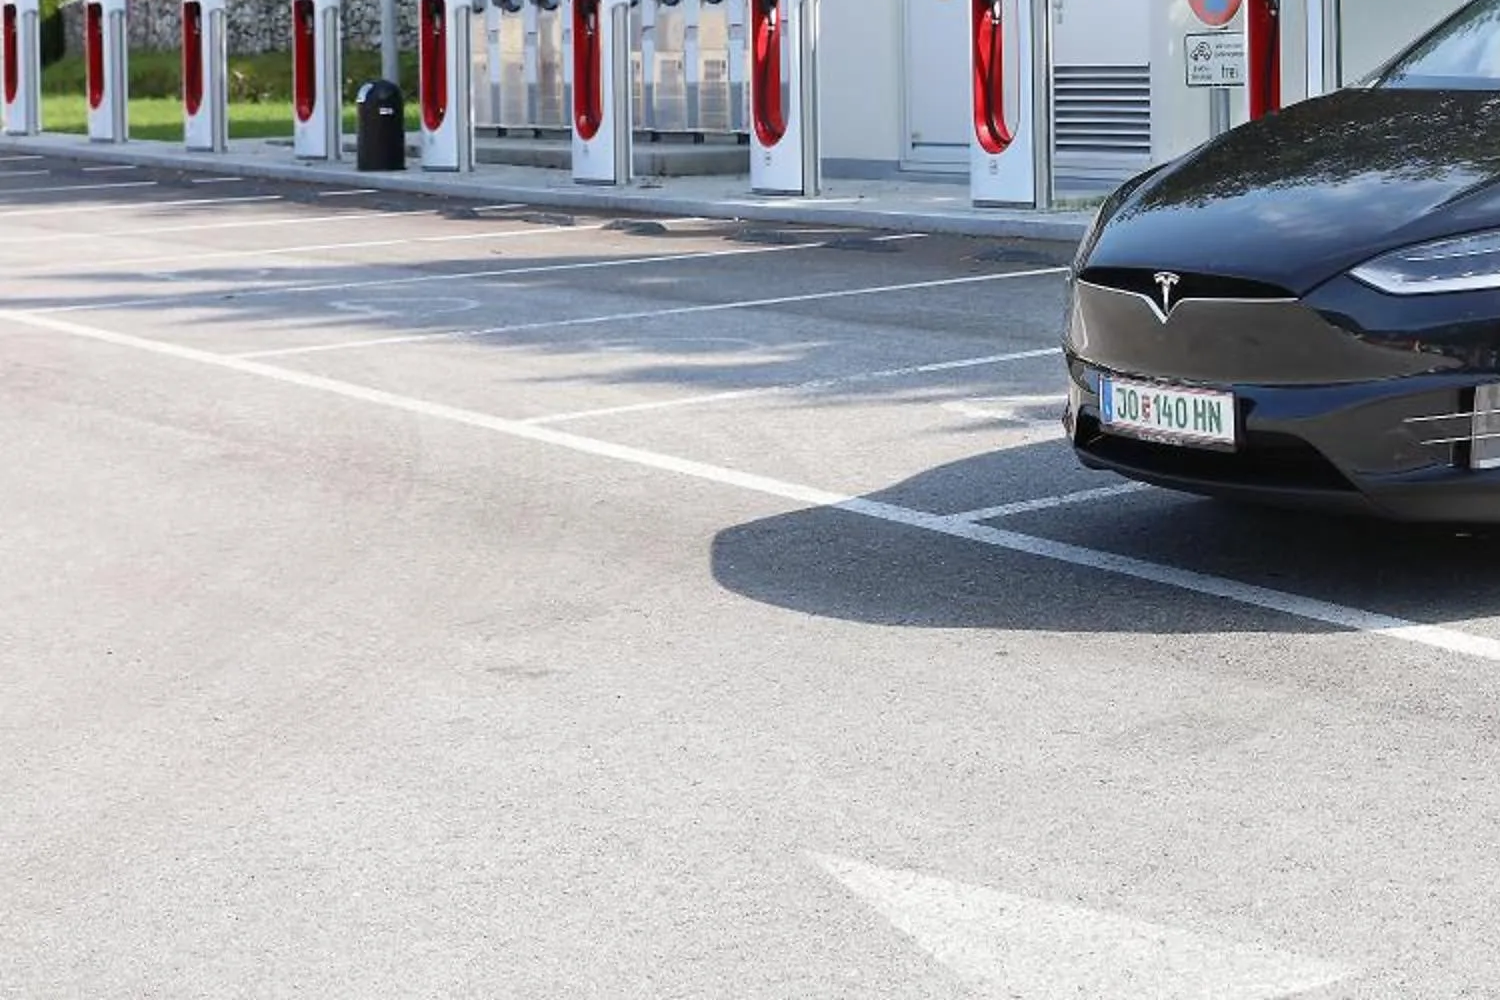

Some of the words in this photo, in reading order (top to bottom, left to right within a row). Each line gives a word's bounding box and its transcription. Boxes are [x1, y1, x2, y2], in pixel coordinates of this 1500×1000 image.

[1116, 387, 1139, 421] JO
[1153, 393, 1188, 429] 140
[1193, 397, 1223, 435] HN
